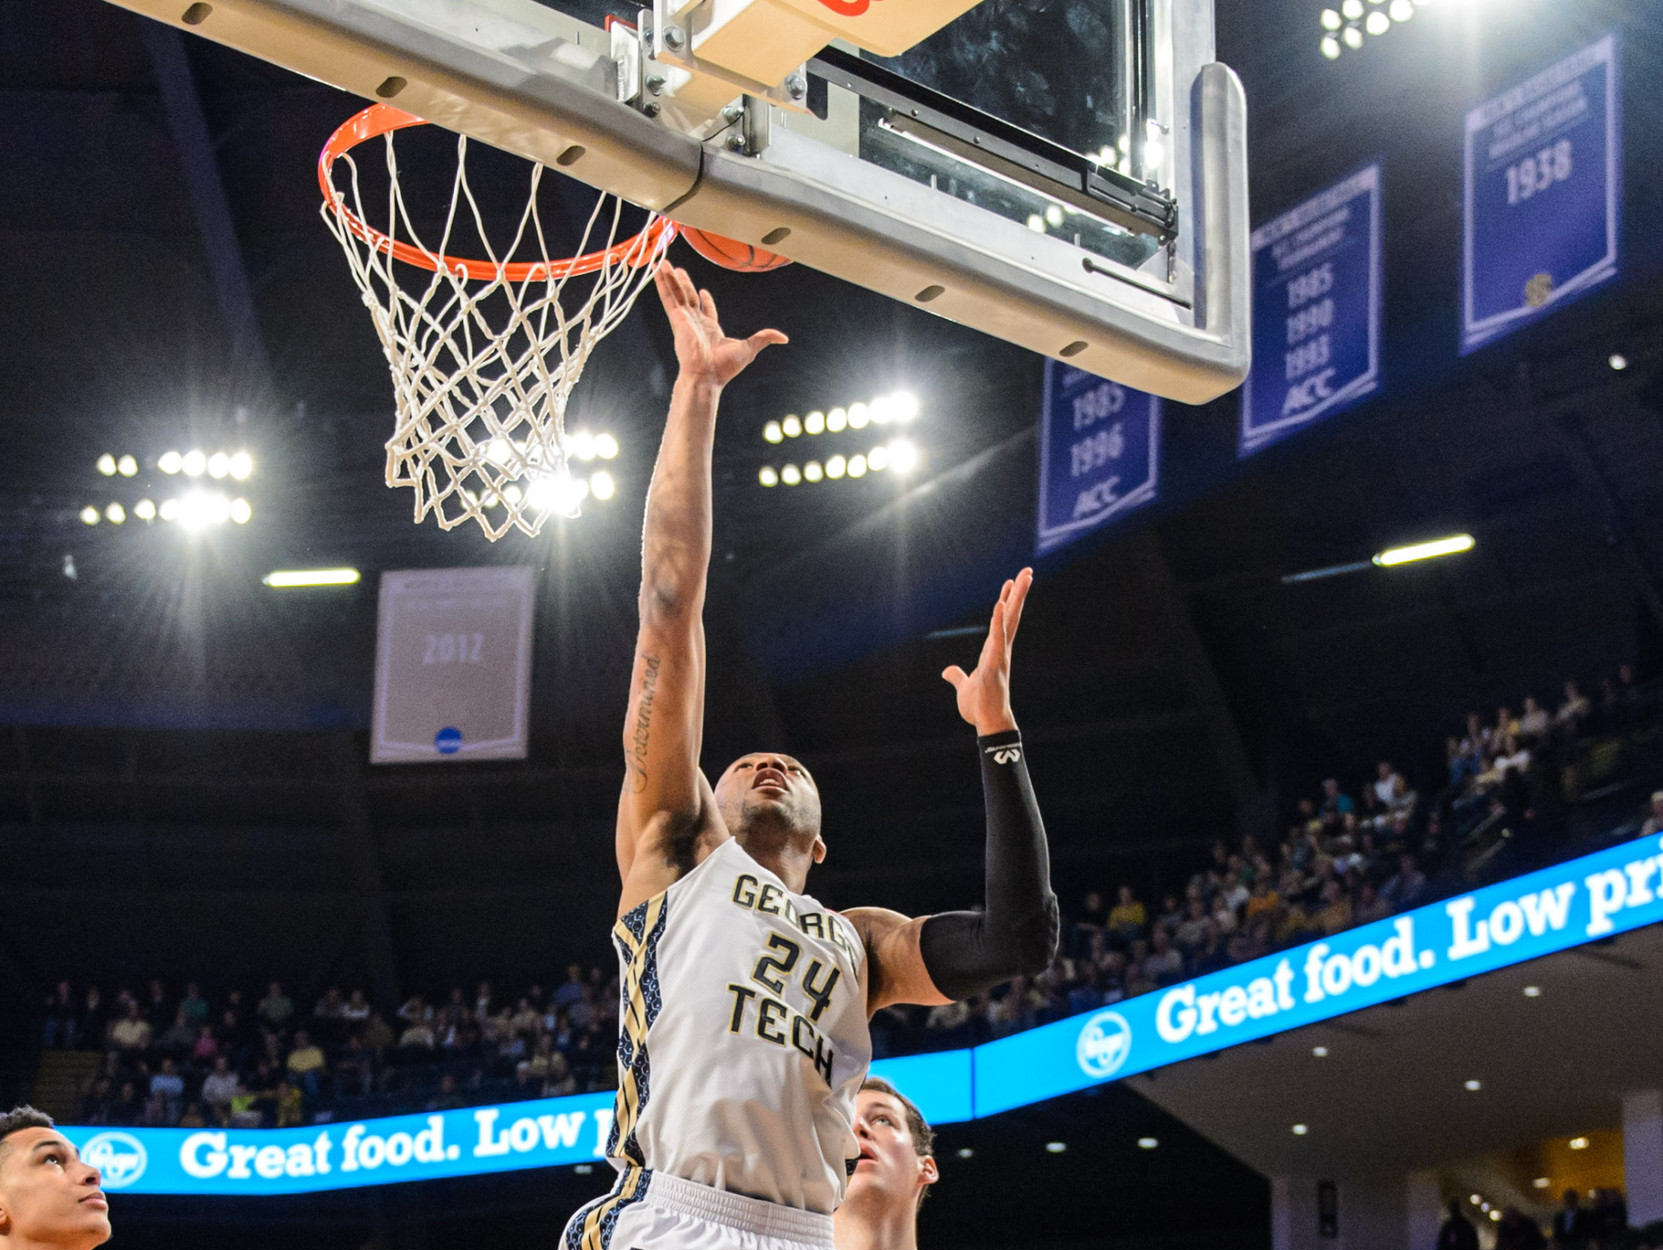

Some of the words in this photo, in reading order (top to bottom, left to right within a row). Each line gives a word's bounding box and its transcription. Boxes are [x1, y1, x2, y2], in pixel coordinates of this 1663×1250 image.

[1506, 139, 1572, 205] 1938
[1281, 366, 1336, 416] ACC
[1072, 475, 1121, 520] ACC
[423, 632, 485, 666] 2012
[732, 873, 861, 984] GEORGI
[1156, 957, 1297, 1043] Great
[1303, 915, 1437, 1004] food.
[1446, 880, 1577, 962] Low
[750, 930, 842, 1025] 24
[727, 983, 834, 1092] TECH
[179, 1130, 333, 1180] Great
[340, 1113, 461, 1173] food.
[472, 1107, 586, 1158] Low
